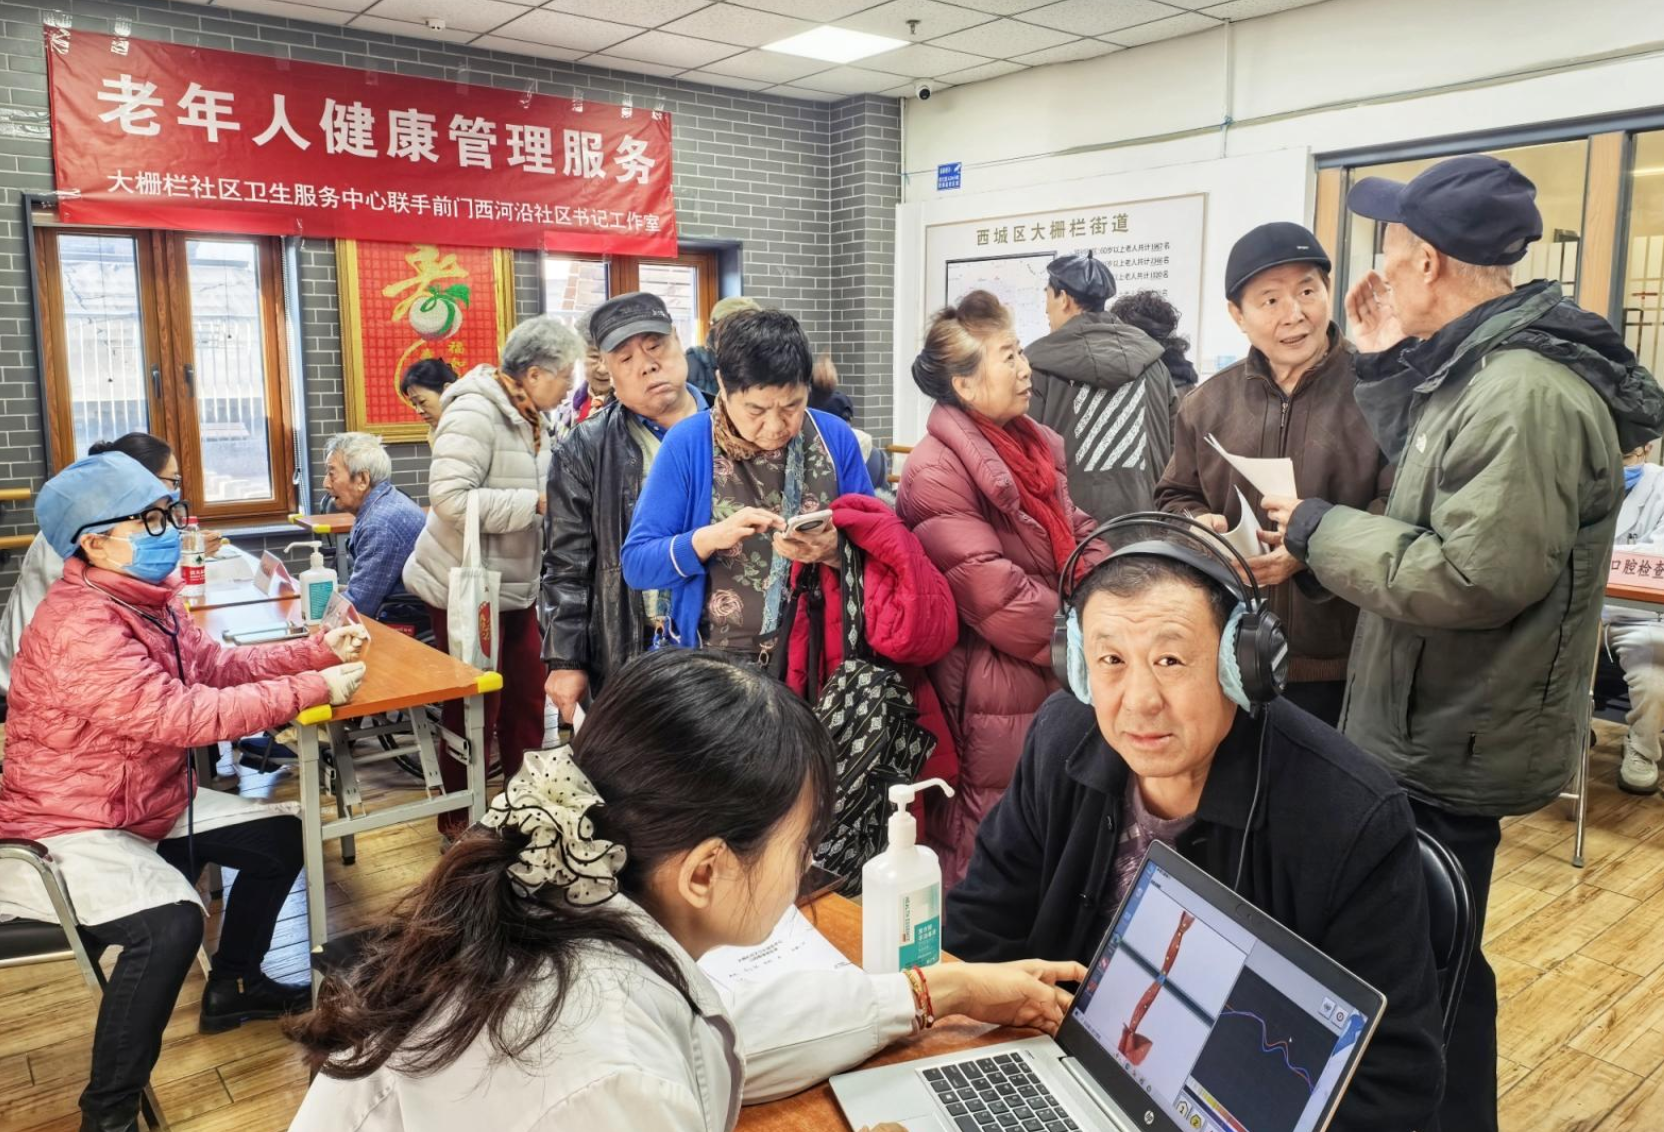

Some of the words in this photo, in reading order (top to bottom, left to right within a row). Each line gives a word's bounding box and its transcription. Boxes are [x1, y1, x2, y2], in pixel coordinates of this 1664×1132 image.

[97, 74, 655, 185] 老年人健康管理服务
[107, 169, 661, 232] 大栅栏社区卫生服务中心联手前门西河沿社区书记工作室
[976, 212, 1130, 246] 西城区大栅栏街道
[1611, 558, 1664, 579] 口腔检查
